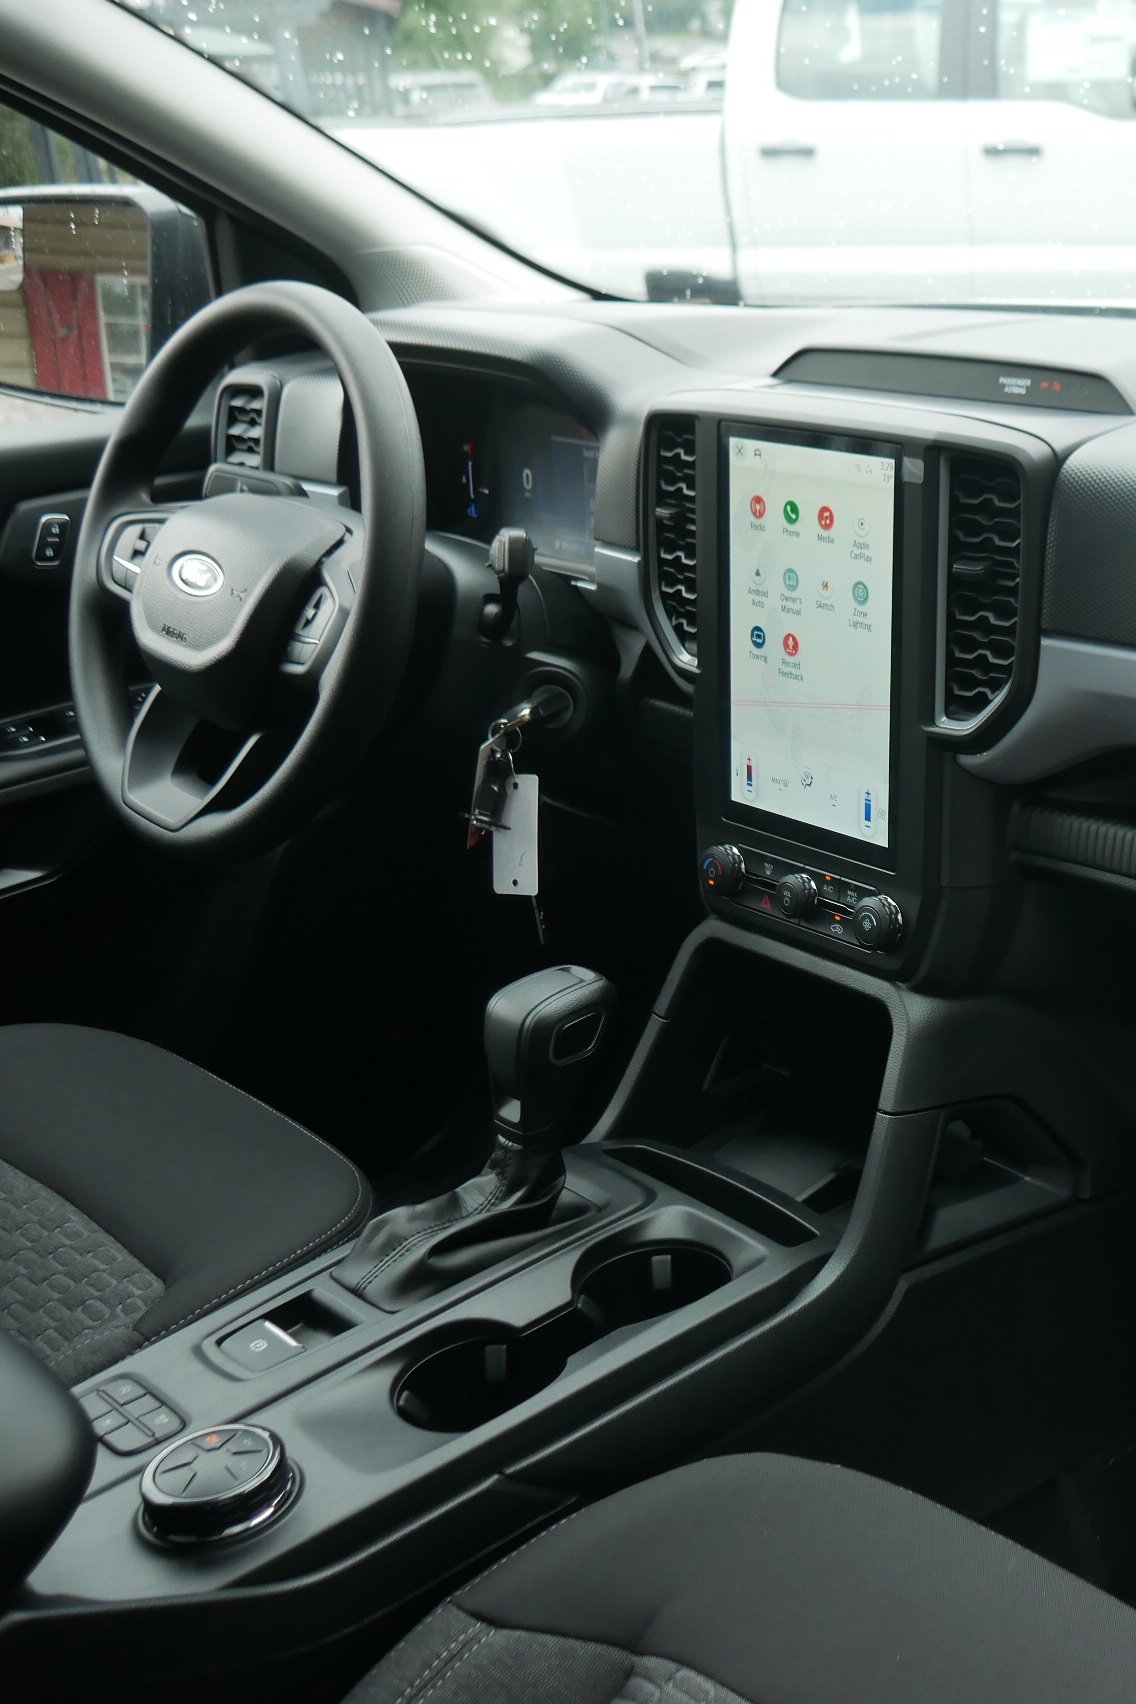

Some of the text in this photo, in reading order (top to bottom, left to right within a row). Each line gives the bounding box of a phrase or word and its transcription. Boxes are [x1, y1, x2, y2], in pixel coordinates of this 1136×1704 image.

[750, 522, 766, 532] Radio
[782, 528, 800, 539] Phone
[817, 533, 835, 545] Media
[853, 540, 870, 551] Apple
[850, 551, 873, 564] CarPlay
[747, 587, 769, 599] Android
[780, 592, 803, 605] Owner's
[751, 598, 765, 609] Auto
[815, 600, 835, 612] Sketch
[781, 604, 802, 616] Manual
[854, 608, 868, 619] Zone
[848, 618, 872, 633] Lighting
[749, 650, 768, 663] Towing
[782, 658, 801, 670] Record
[778, 668, 804, 682] Feedback
[783, 890, 792, 898] VOL
[823, 884, 834, 893] A/C
[847, 890, 858, 898] MAX
